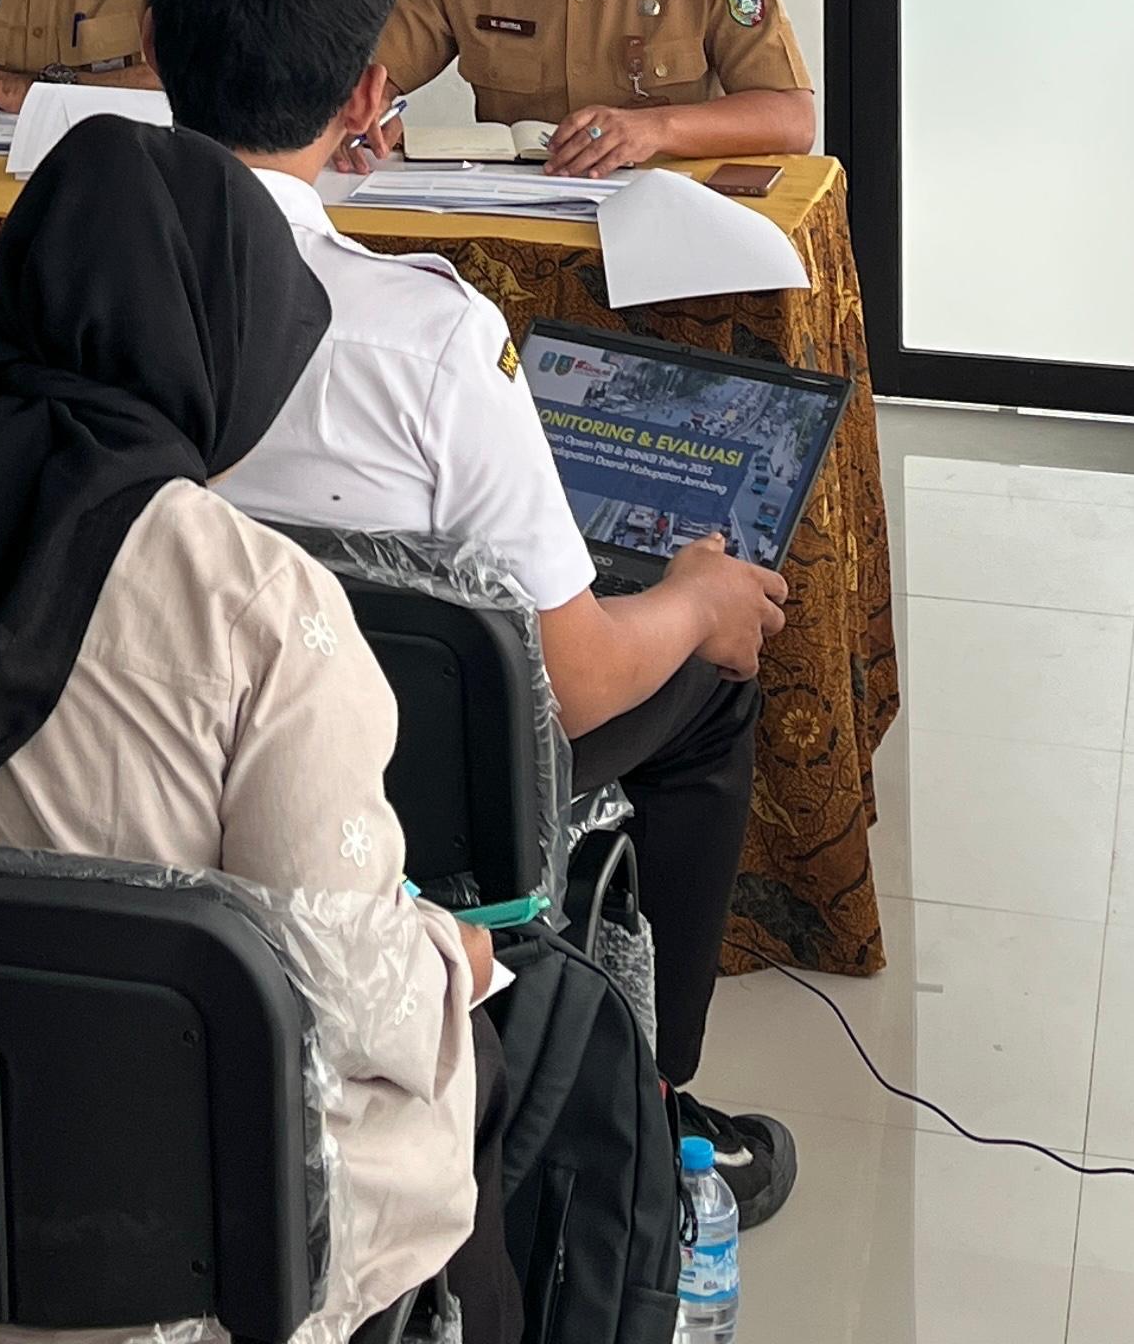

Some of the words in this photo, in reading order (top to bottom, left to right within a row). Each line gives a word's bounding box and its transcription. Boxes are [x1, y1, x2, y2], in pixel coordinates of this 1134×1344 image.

[539, 408, 635, 443] ONITORING
[637, 431, 652, 447] &
[656, 434, 744, 467] EVALUASI
